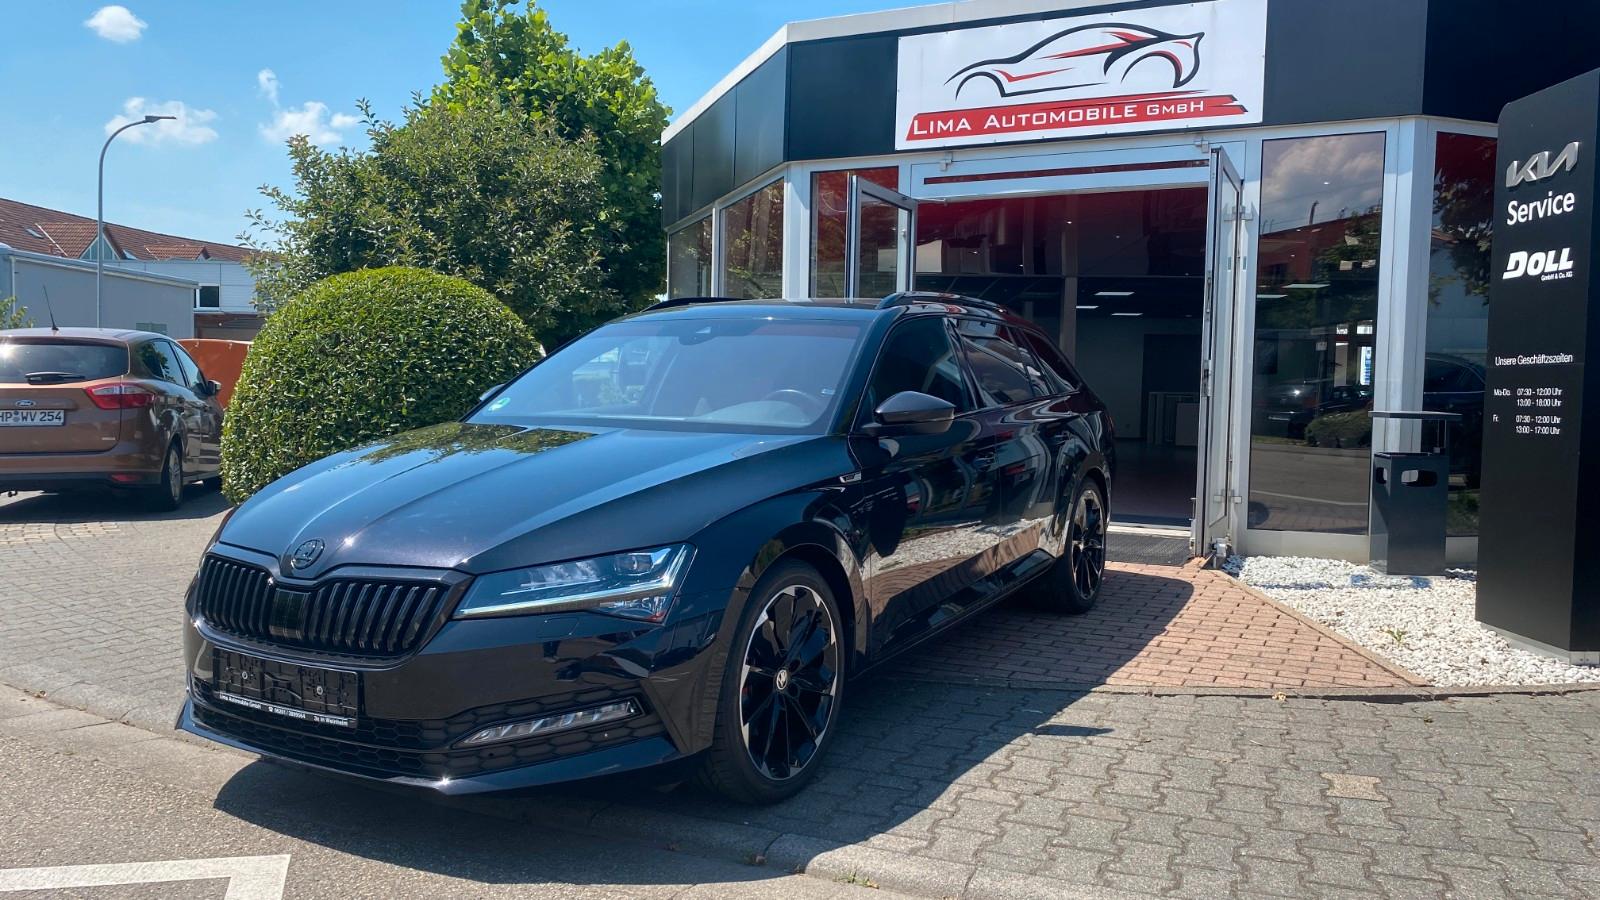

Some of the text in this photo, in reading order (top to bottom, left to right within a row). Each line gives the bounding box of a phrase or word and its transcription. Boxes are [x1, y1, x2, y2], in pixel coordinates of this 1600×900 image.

[1507, 191, 1575, 225] Service
[1495, 356, 1516, 366] Unsere
[21, 412, 37, 422] WV
[40, 412, 62, 422] 254
